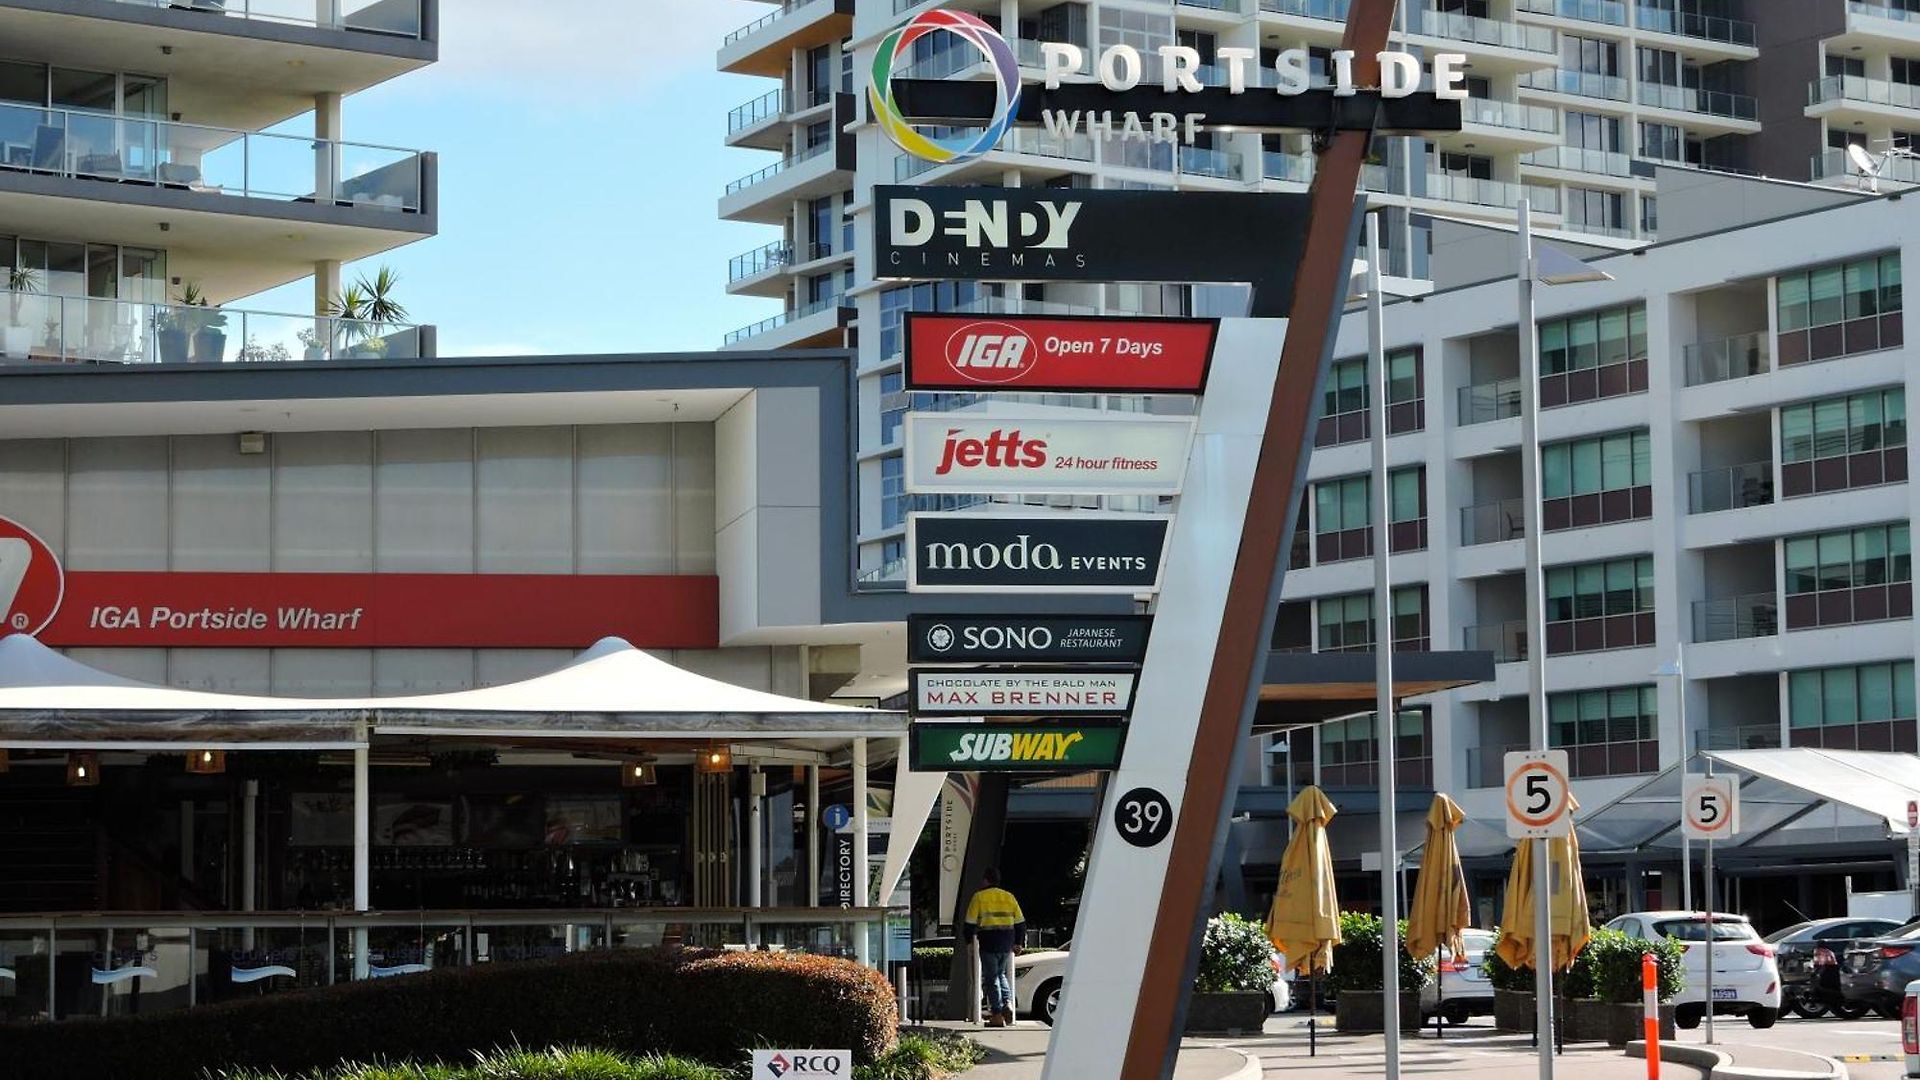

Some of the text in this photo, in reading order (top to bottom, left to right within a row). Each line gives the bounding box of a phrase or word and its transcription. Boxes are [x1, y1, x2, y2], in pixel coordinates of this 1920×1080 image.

[1041, 42, 1469, 99] PORTSIDE
[1041, 109, 1206, 144] WHARF
[889, 198, 1083, 249] DENDY
[890, 251, 1086, 269] CINEMAS
[956, 334, 1163, 369] IGA Open 7 Days
[936, 428, 1158, 475] jetts 24 hour fitness
[925, 535, 1146, 571] moda EVENTS
[90, 606, 362, 630] IGA Portside Wharf
[963, 626, 1116, 649] SONO JAPANESE
[1060, 638, 1123, 648] RESTAURANT
[927, 679, 1116, 688] CHOCOLATE BY THE BALD MAN
[927, 691, 1117, 705] MAX BRENNER
[950, 731, 1084, 762] SUBWAY
[1526, 775, 1551, 814] 5
[1699, 796, 1718, 823] 5
[1124, 801, 1163, 833] 39
[794, 1056, 840, 1075] RCQ
